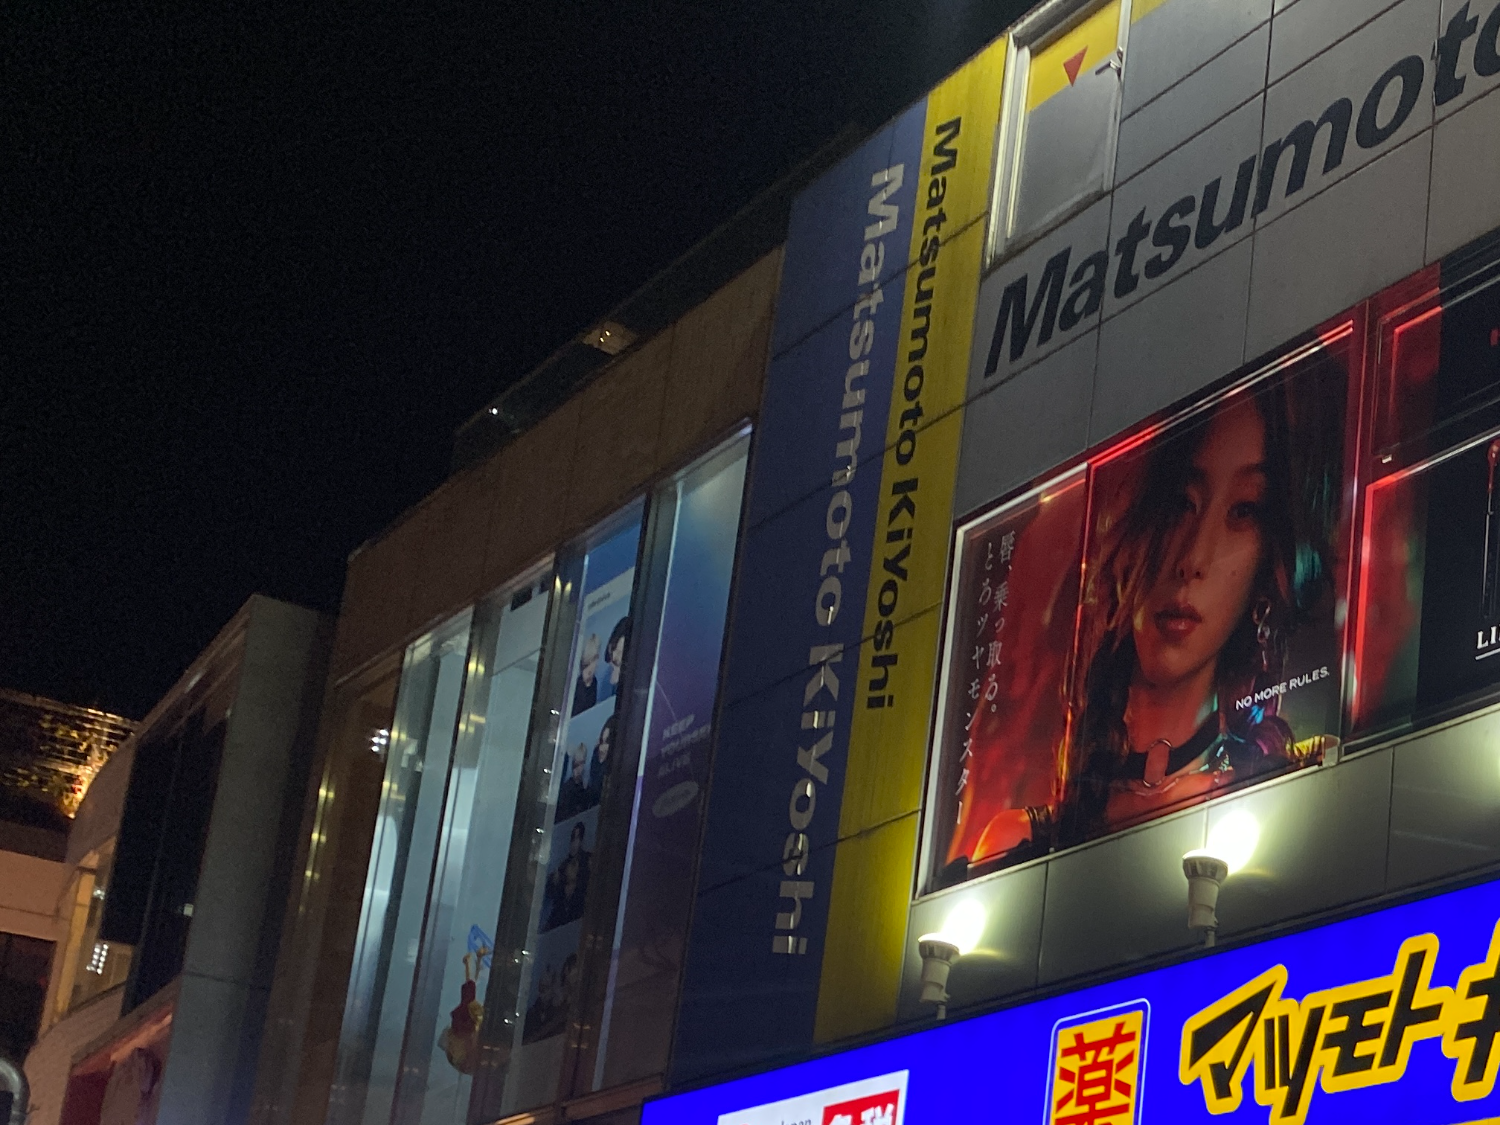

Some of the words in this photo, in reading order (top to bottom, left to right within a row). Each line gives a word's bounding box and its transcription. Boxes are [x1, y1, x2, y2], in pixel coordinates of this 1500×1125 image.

[811, 162, 906, 627] Matsumoto
[890, 117, 962, 464] Matsumoto
[866, 475, 920, 711] KiYoshi
[1235, 695, 1253, 711] NO
[1254, 682, 1288, 704] MORE
[772, 642, 847, 957] KiYoshi
